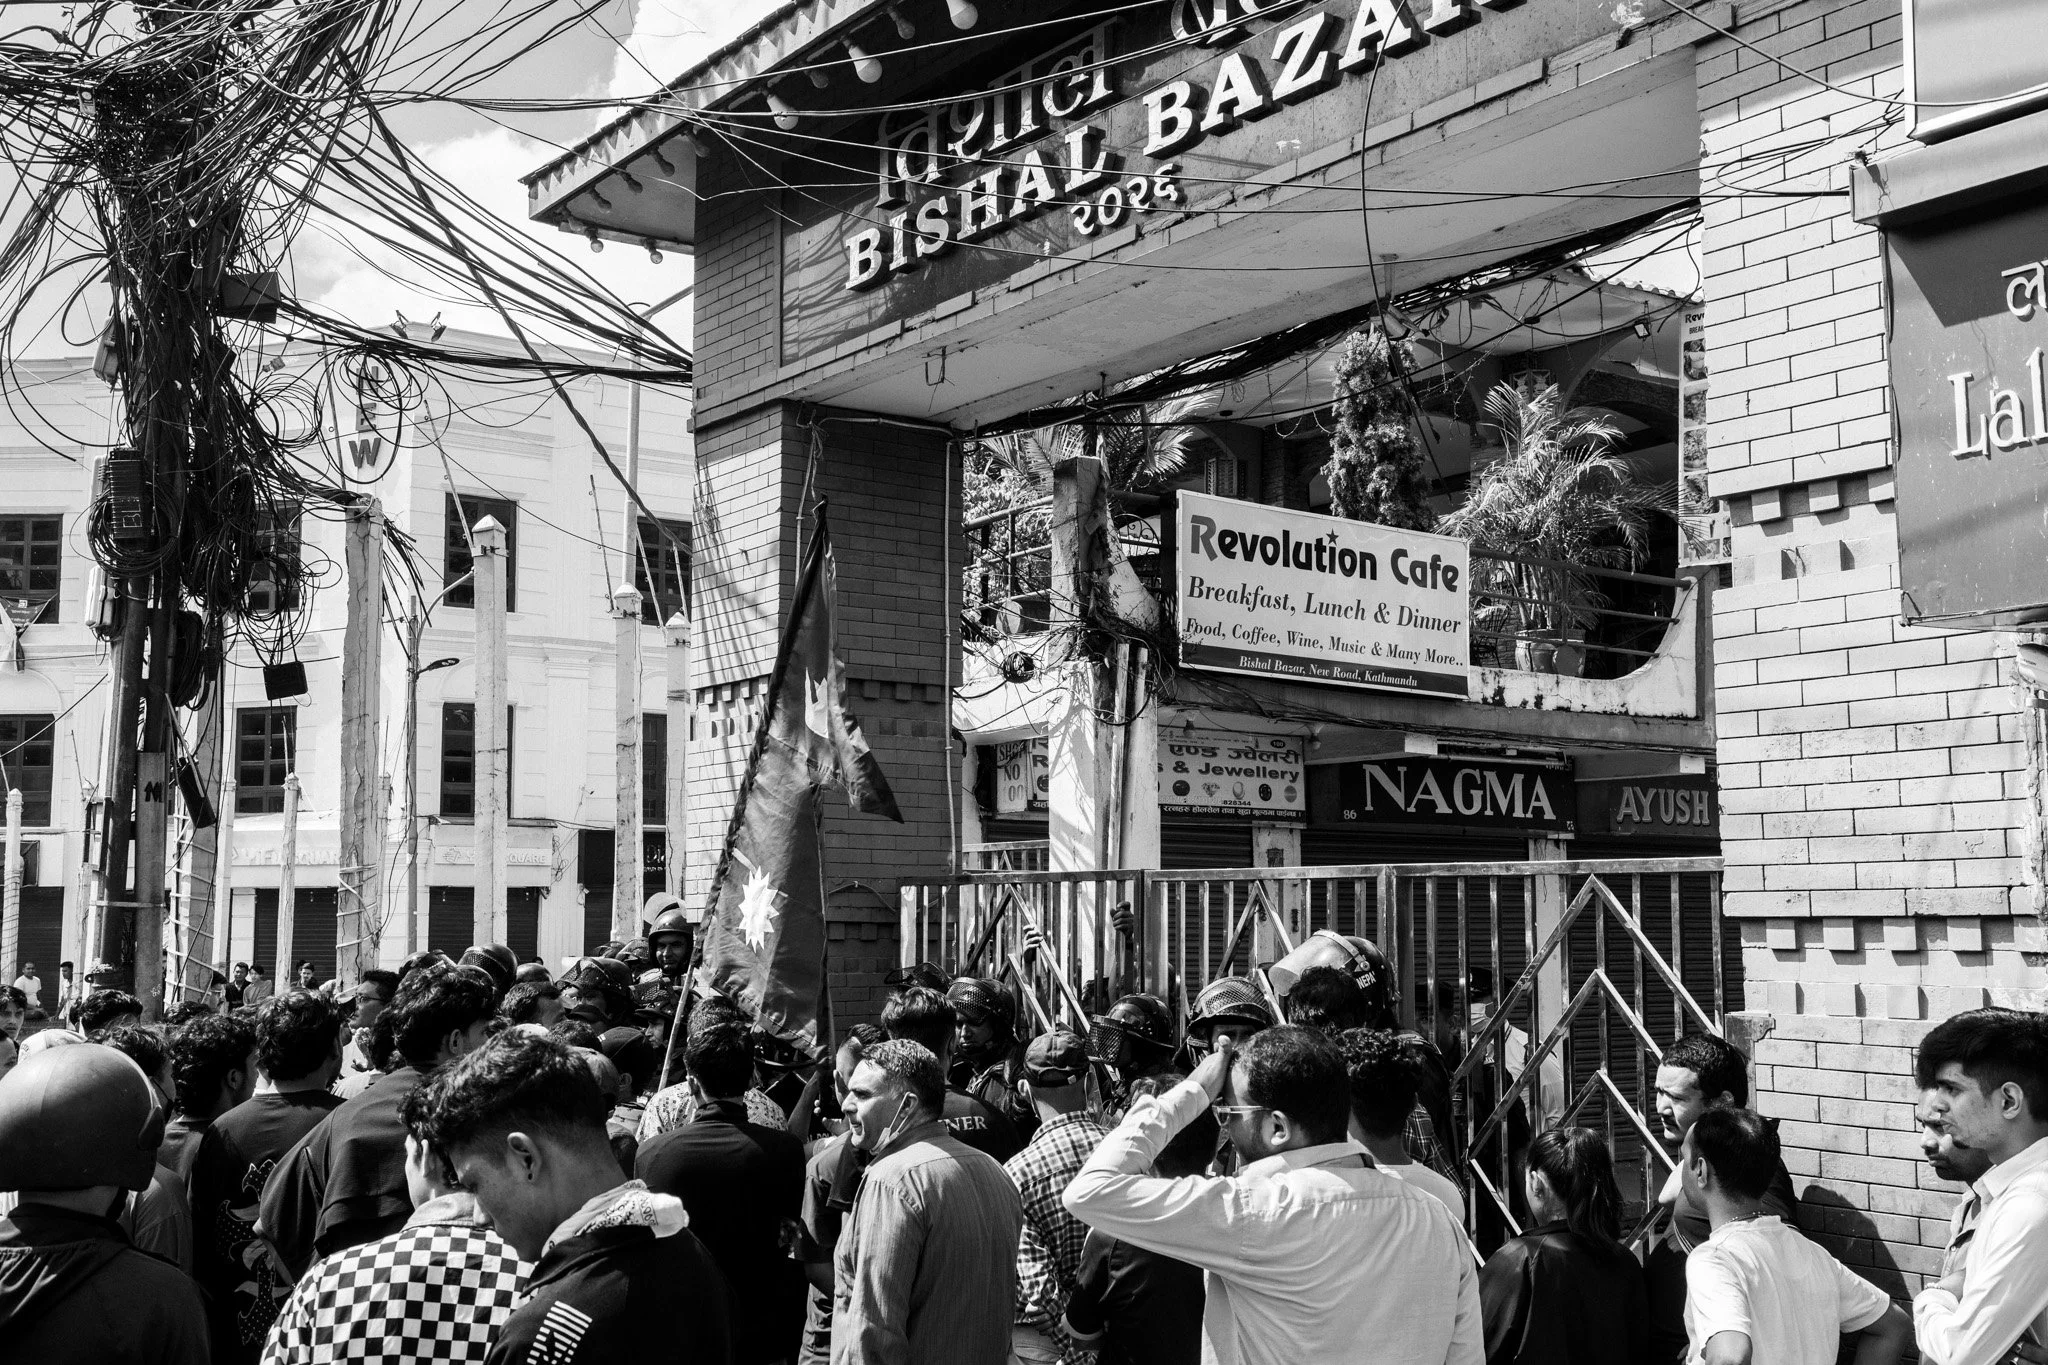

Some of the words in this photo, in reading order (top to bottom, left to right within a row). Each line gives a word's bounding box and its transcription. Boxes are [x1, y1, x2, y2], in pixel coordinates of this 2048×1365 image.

[845, 125, 1109, 289] BISHAL
[1190, 514, 1377, 581] Revolution
[1390, 548, 1459, 592] Cafe
[1187, 575, 1296, 616] Breakfast,
[1303, 592, 1366, 621] Lunch
[1374, 602, 1390, 624] &
[1396, 605, 1461, 634] Dinner
[1185, 617, 1226, 640] Food,
[1232, 624, 1281, 646] Coffee,
[1287, 630, 1324, 651] Wine,
[1328, 636, 1366, 655] Music
[1371, 641, 1382, 656] &
[1386, 643, 1421, 666] Many
[1424, 648, 1464, 667] More..
[1239, 655, 1271, 670] Bishal
[1274, 659, 1305, 676] Bazar,
[1308, 663, 1331, 677] New
[1333, 667, 1361, 682] Road,
[1364, 670, 1418, 687] Kathmandu
[1168, 744, 1220, 758] एण्ड
[1004, 763, 1021, 781] NO
[1172, 760, 1190, 773] &
[1198, 762, 1300, 783] Jewellery
[1362, 763, 1557, 820] NAGMA
[1616, 786, 1711, 826] AYUSH
[1343, 809, 1357, 820] 86
[938, 1115, 988, 1132] NER
